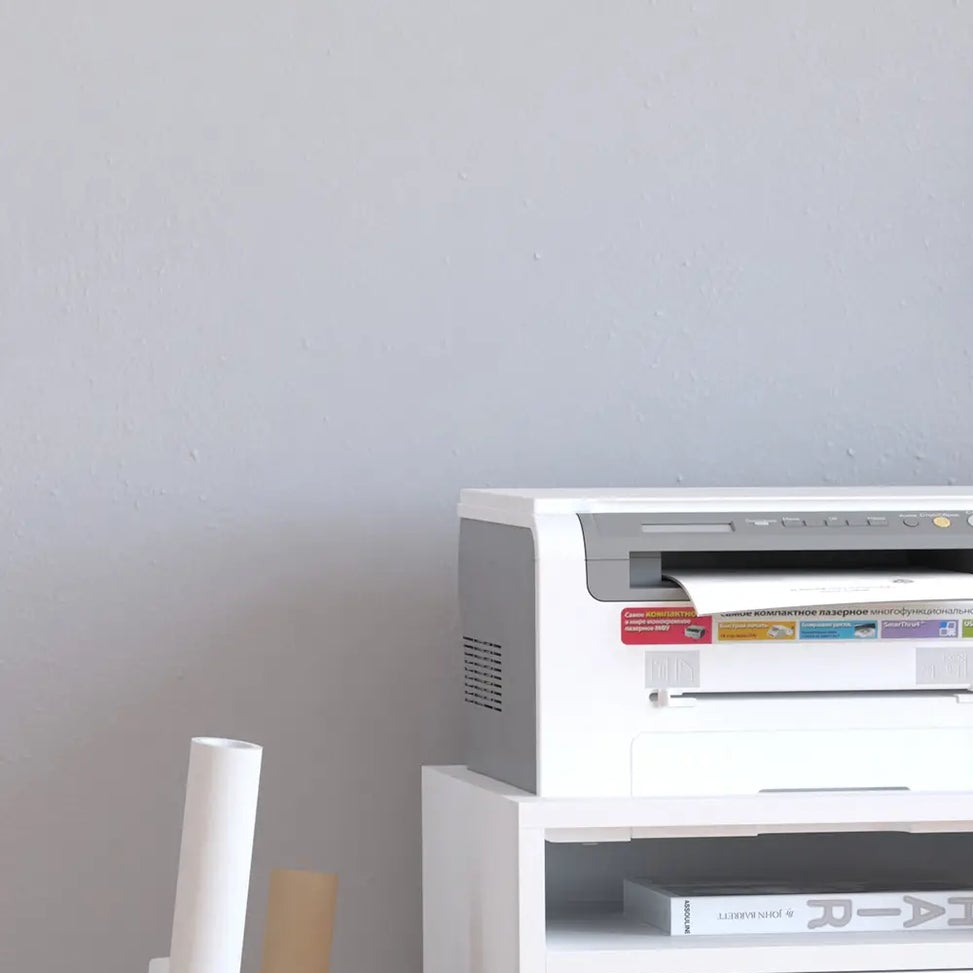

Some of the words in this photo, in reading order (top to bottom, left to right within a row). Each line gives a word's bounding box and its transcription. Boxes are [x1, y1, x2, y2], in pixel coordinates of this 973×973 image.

[754, 609, 817, 617] компактное
[819, 608, 869, 618] лазерное
[683, 900, 691, 935] ASSOULINE
[717, 910, 756, 921] BARRETT
[757, 908, 782, 919] JOHN
